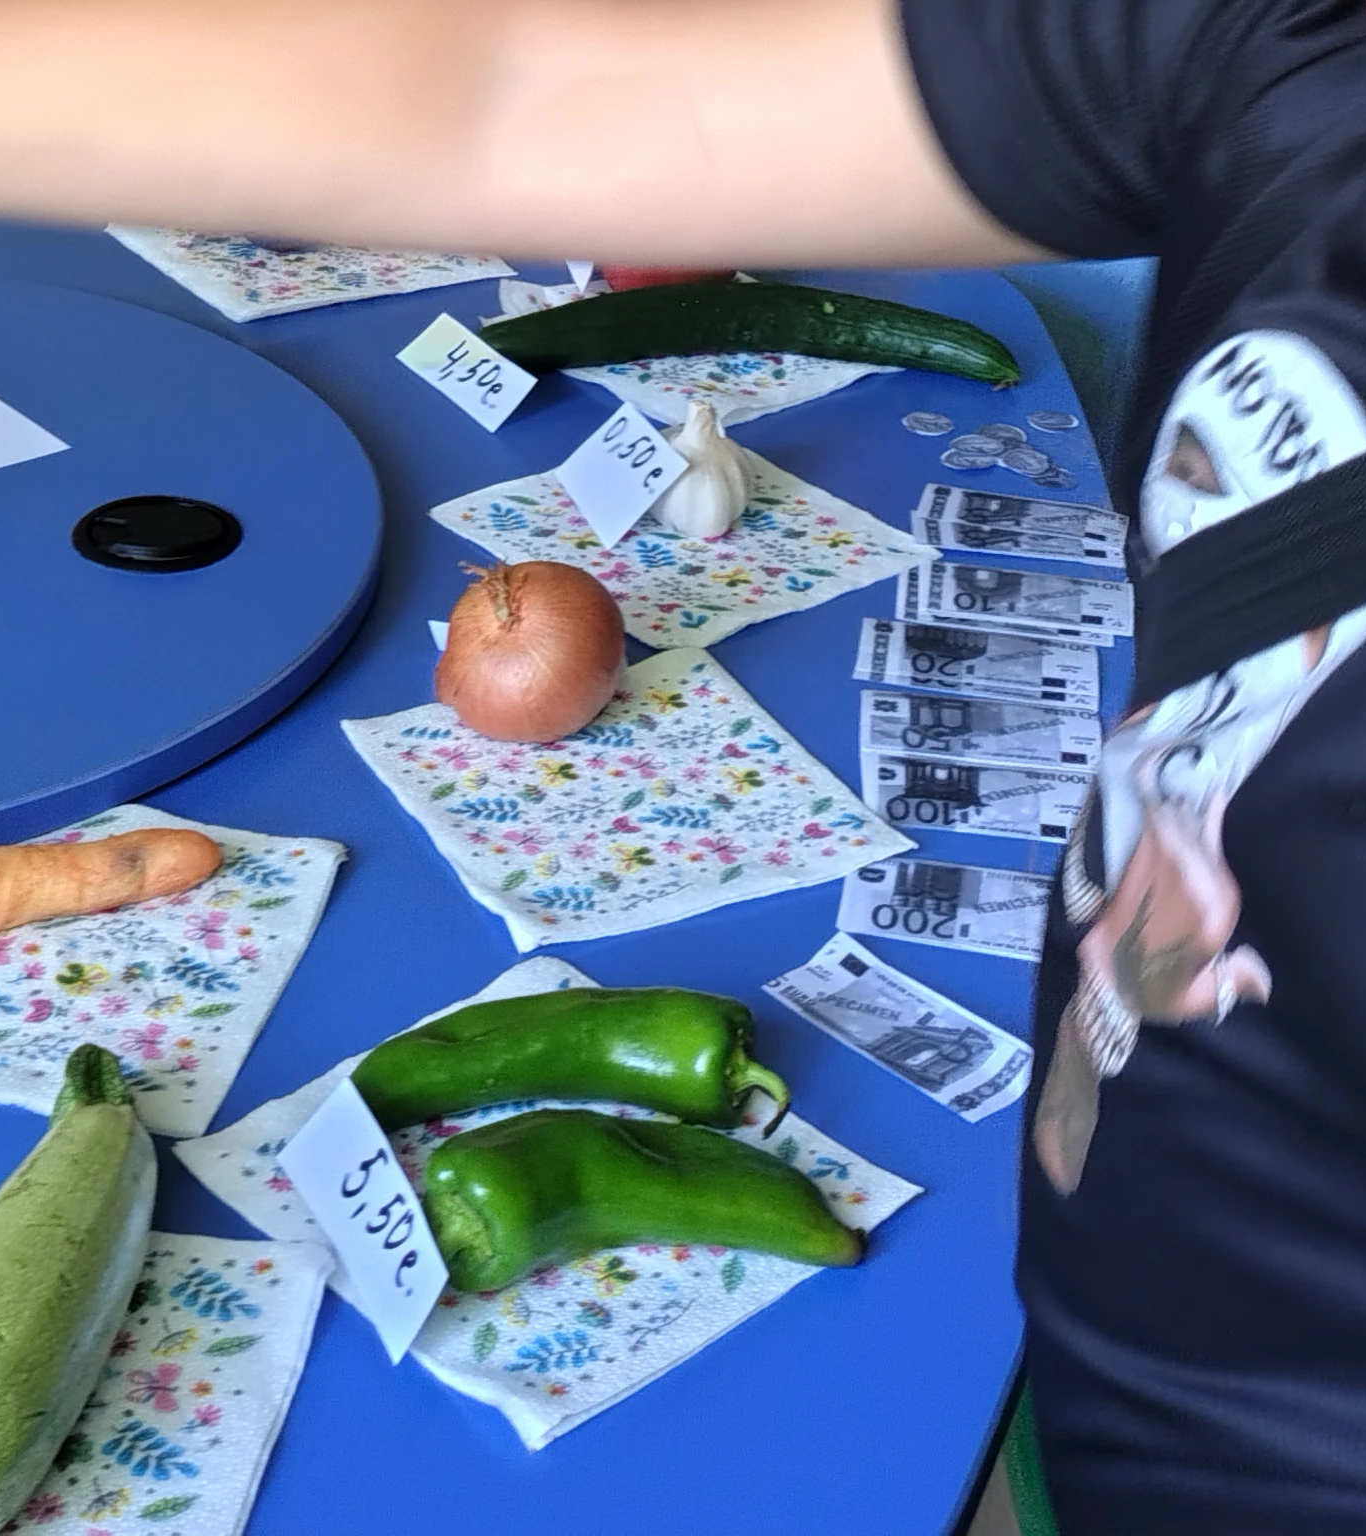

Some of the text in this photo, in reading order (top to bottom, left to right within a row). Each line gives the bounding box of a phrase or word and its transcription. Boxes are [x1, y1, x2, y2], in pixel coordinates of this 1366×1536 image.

[953, 592, 994, 613] 10
[911, 652, 960, 677] 20
[900, 726, 951, 753] 50
[885, 795, 955, 825] 100
[871, 904, 958, 940] 200
